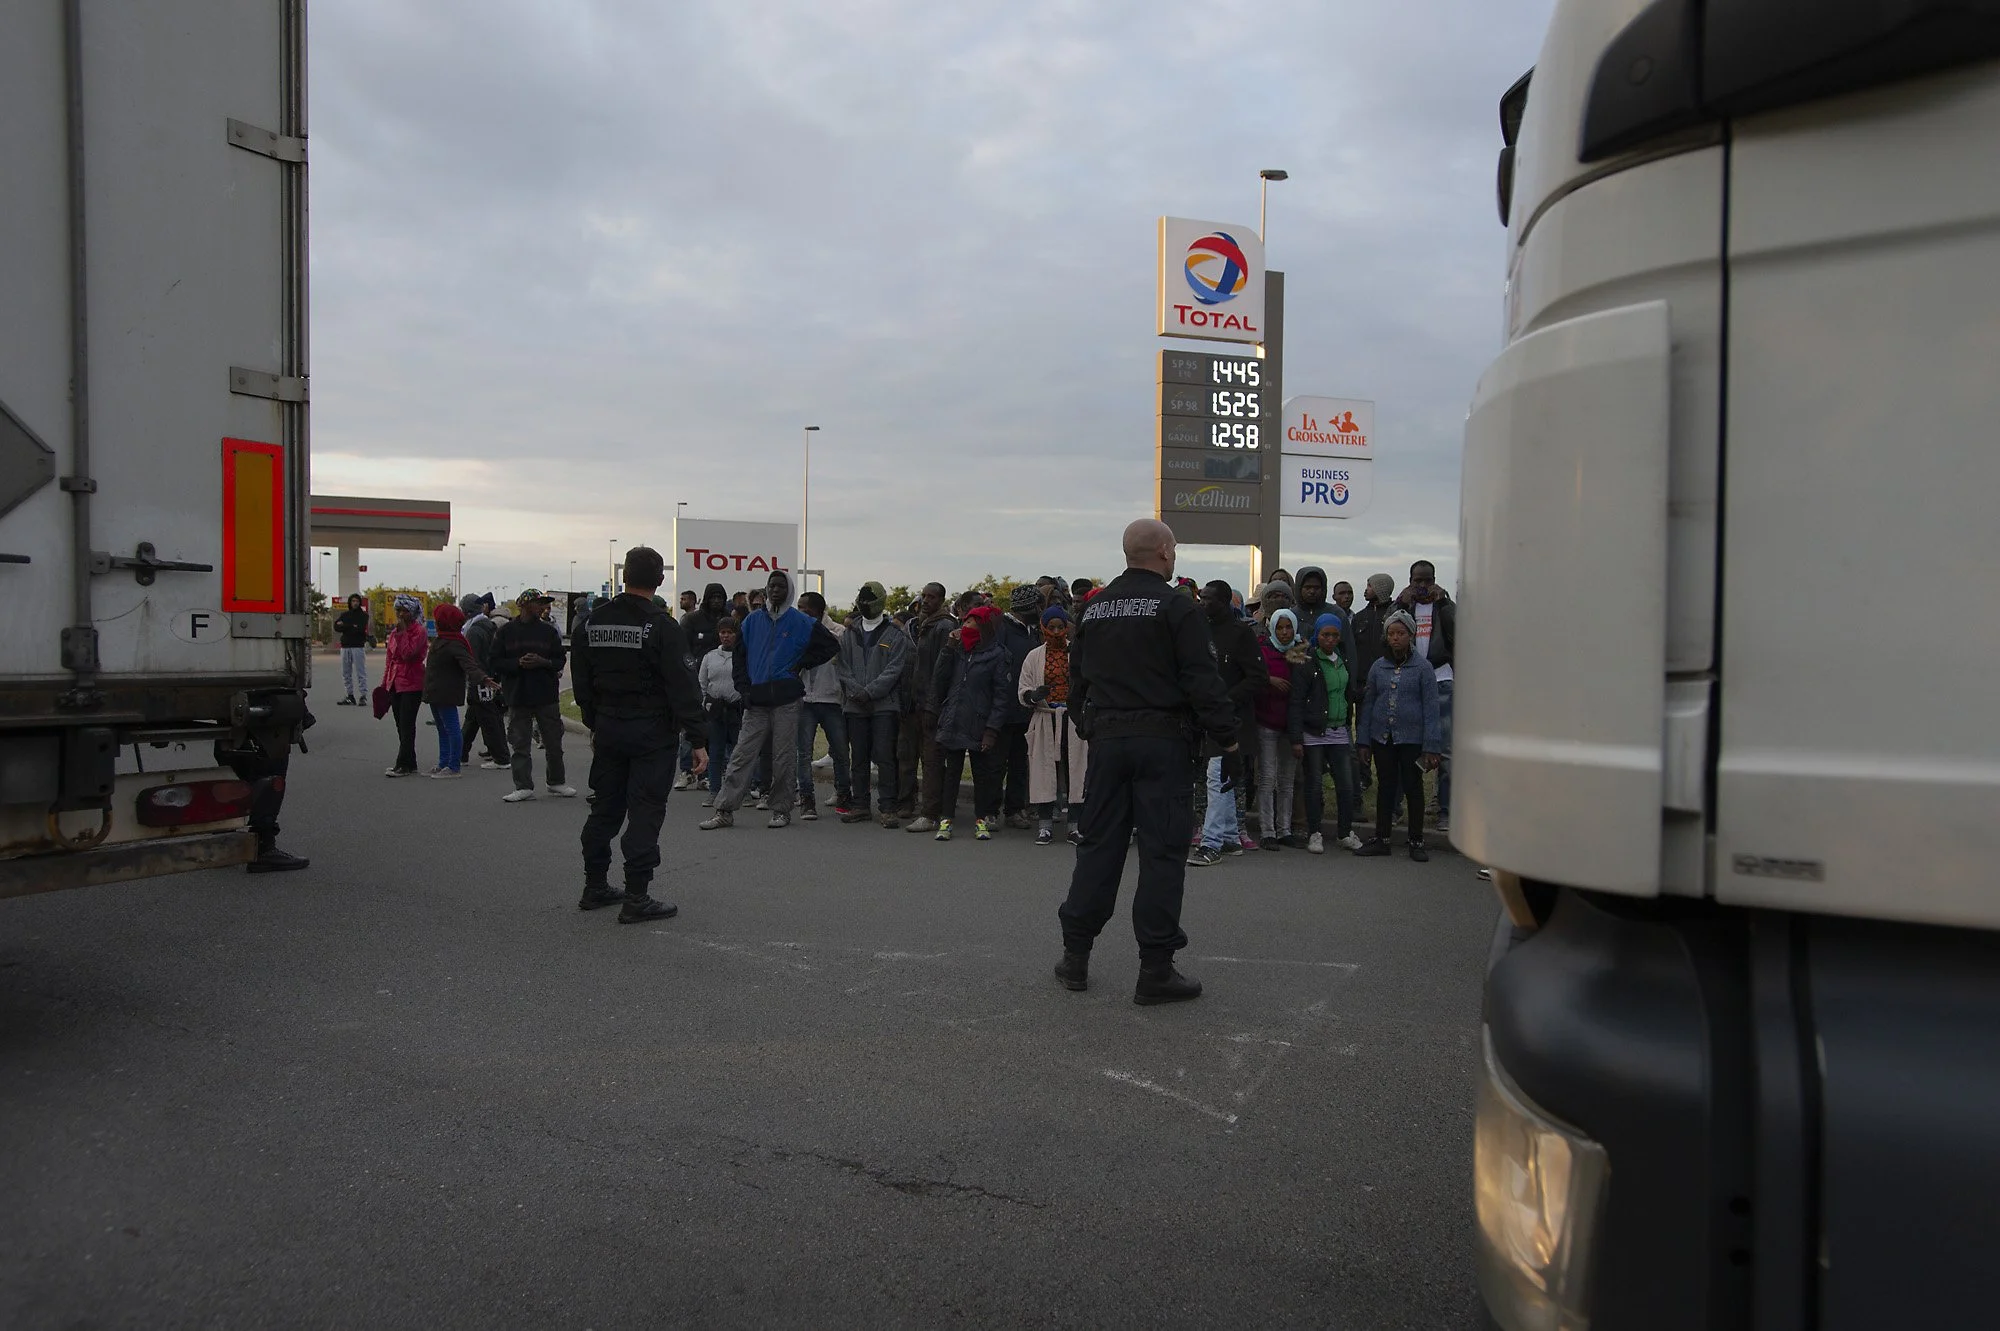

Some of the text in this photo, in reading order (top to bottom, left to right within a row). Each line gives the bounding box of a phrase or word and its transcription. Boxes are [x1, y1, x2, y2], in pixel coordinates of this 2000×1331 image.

[1173, 304, 1257, 331] TOTAL
[1172, 359, 1197, 370] SP 95
[1170, 400, 1198, 411] SP 98
[1287, 427, 1367, 446] CROISSANTERIE
[1302, 468, 1349, 481] BUSINESS
[1174, 490, 1250, 509] excellium
[686, 548, 789, 573] TOTAL
[1081, 598, 1160, 623] GENDARMERIE
[191, 613, 210, 639] F
[589, 629, 640, 644] GENDARMERIE
